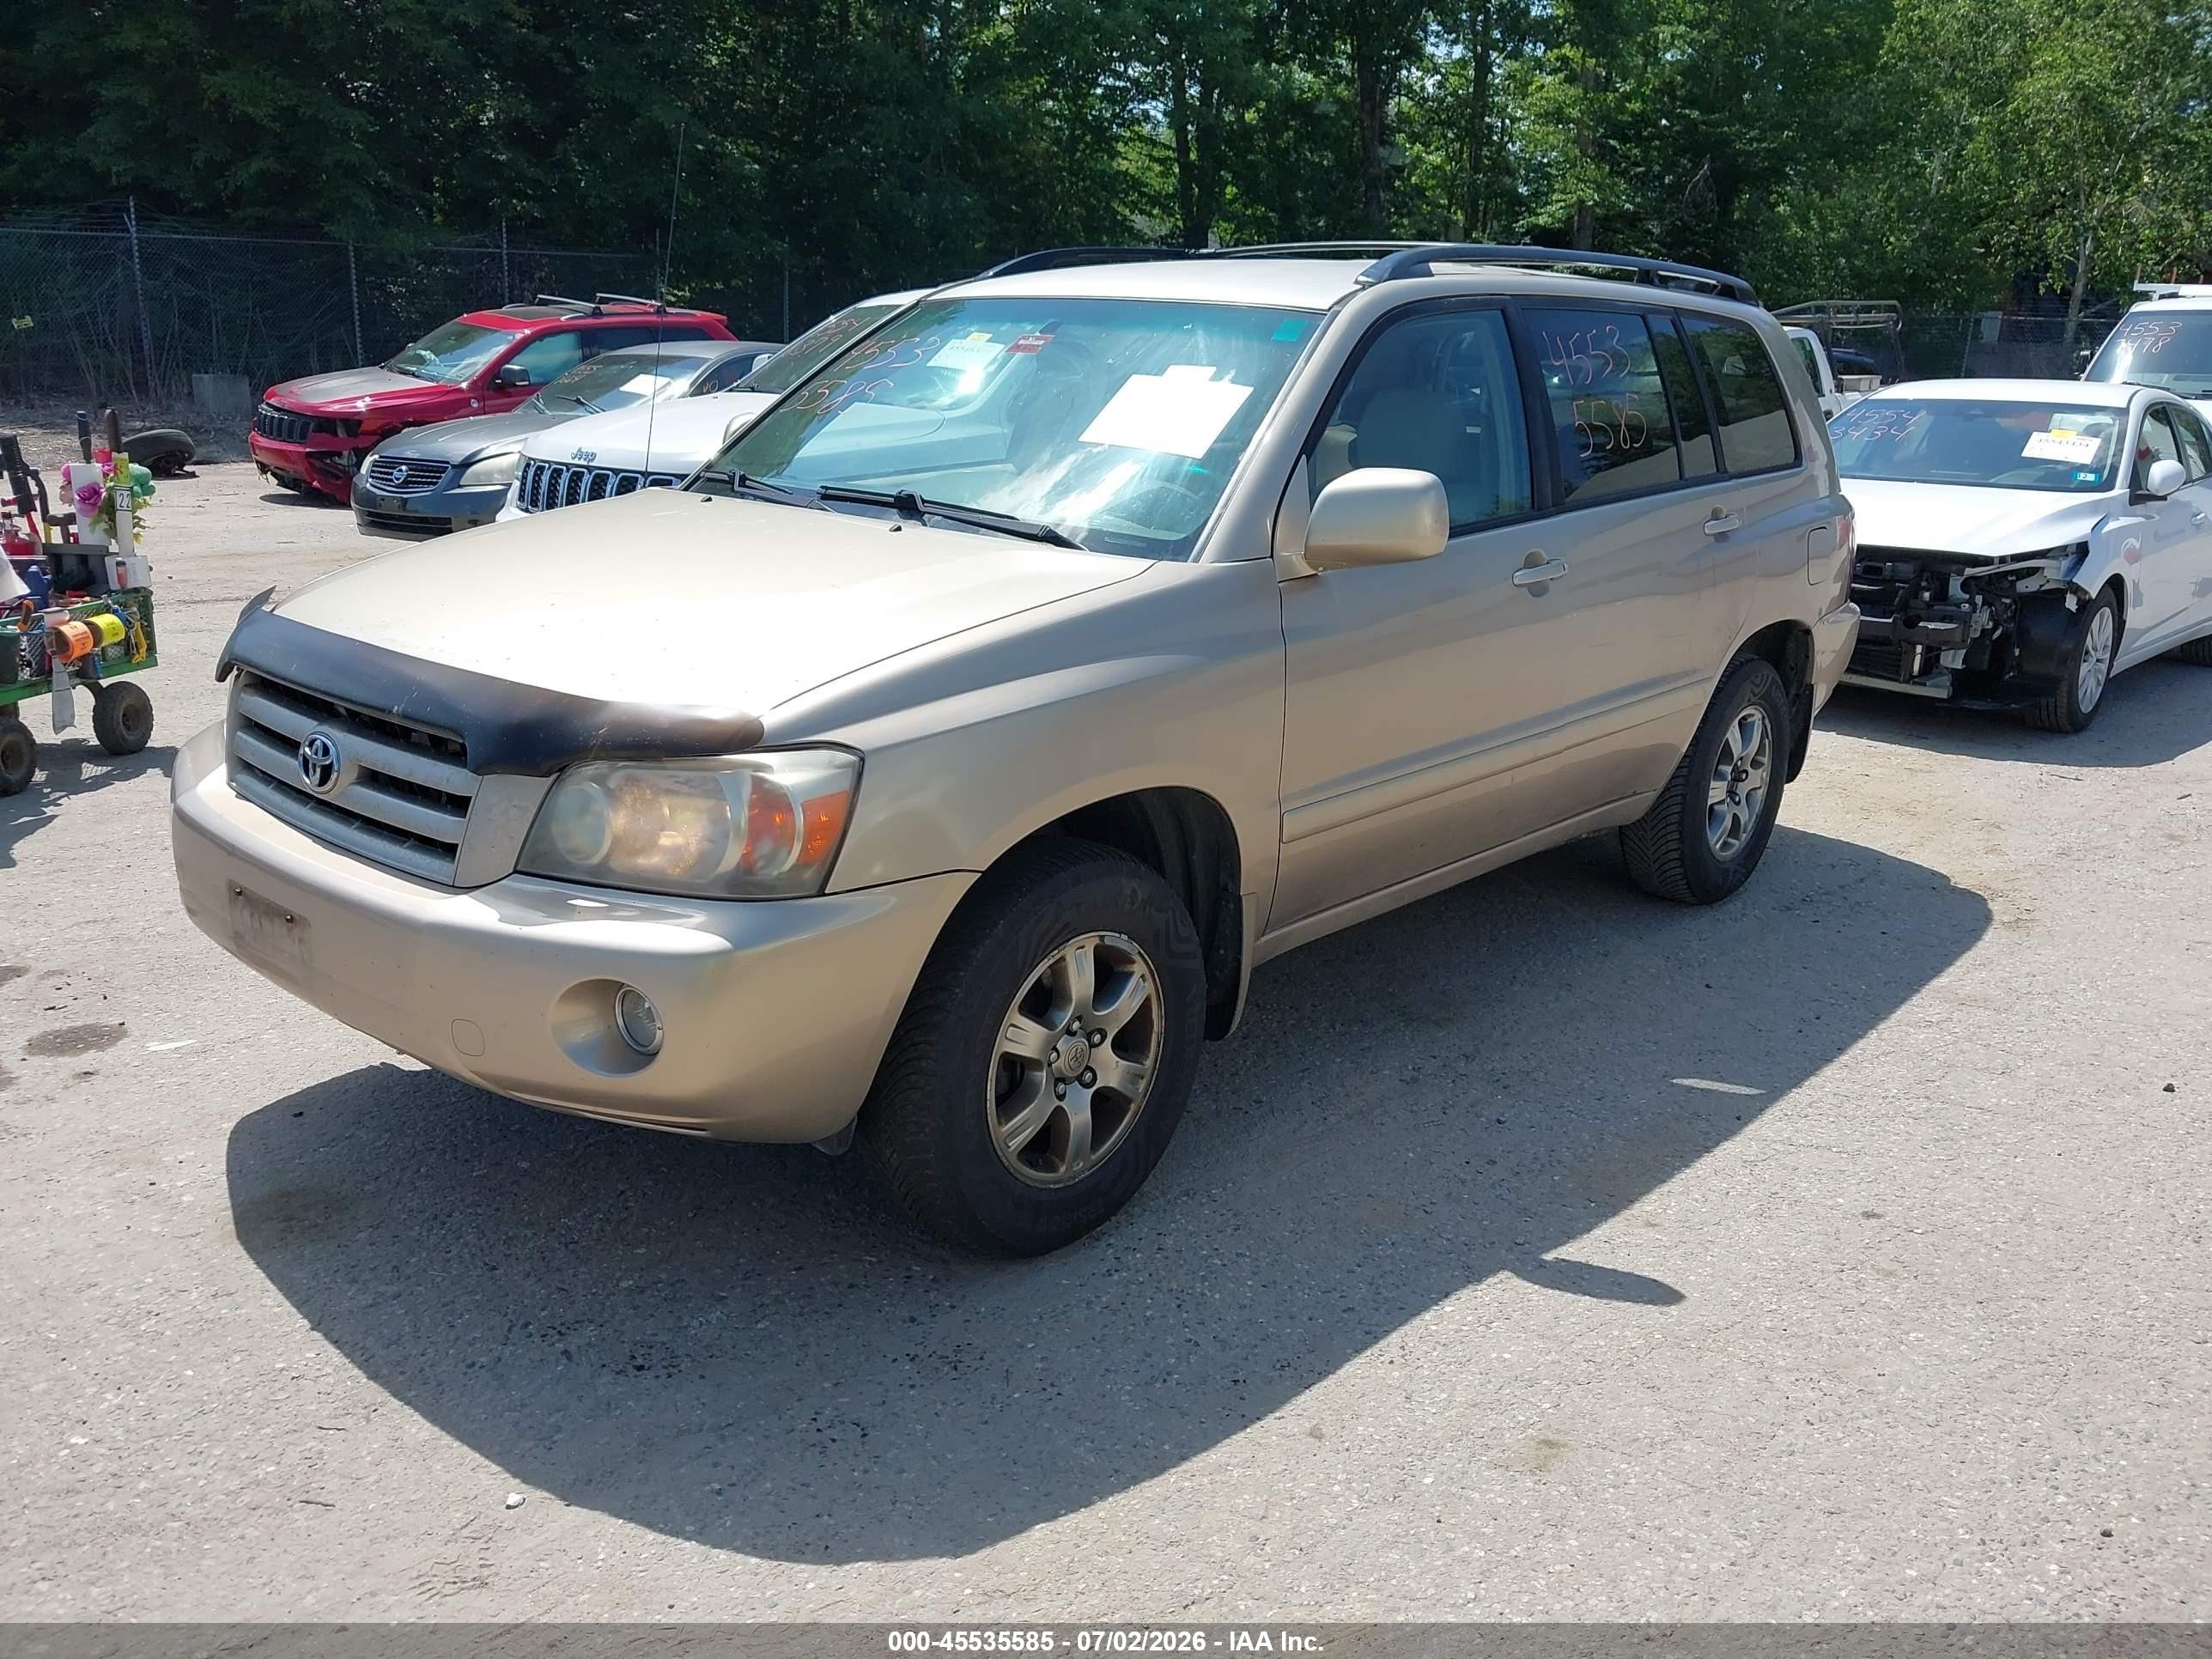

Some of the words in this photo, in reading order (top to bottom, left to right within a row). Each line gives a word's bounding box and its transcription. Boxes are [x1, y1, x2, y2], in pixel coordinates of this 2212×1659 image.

[2119, 321, 2183, 337] 4553
[834, 337, 941, 372] 4553
[1542, 325, 1632, 386] 4553
[779, 378, 895, 415] 5585
[1571, 392, 1647, 457] 5585
[1846, 408, 1927, 426] 4554
[1830, 426, 1916, 442] 3434
[570, 447, 598, 465] Jeep
